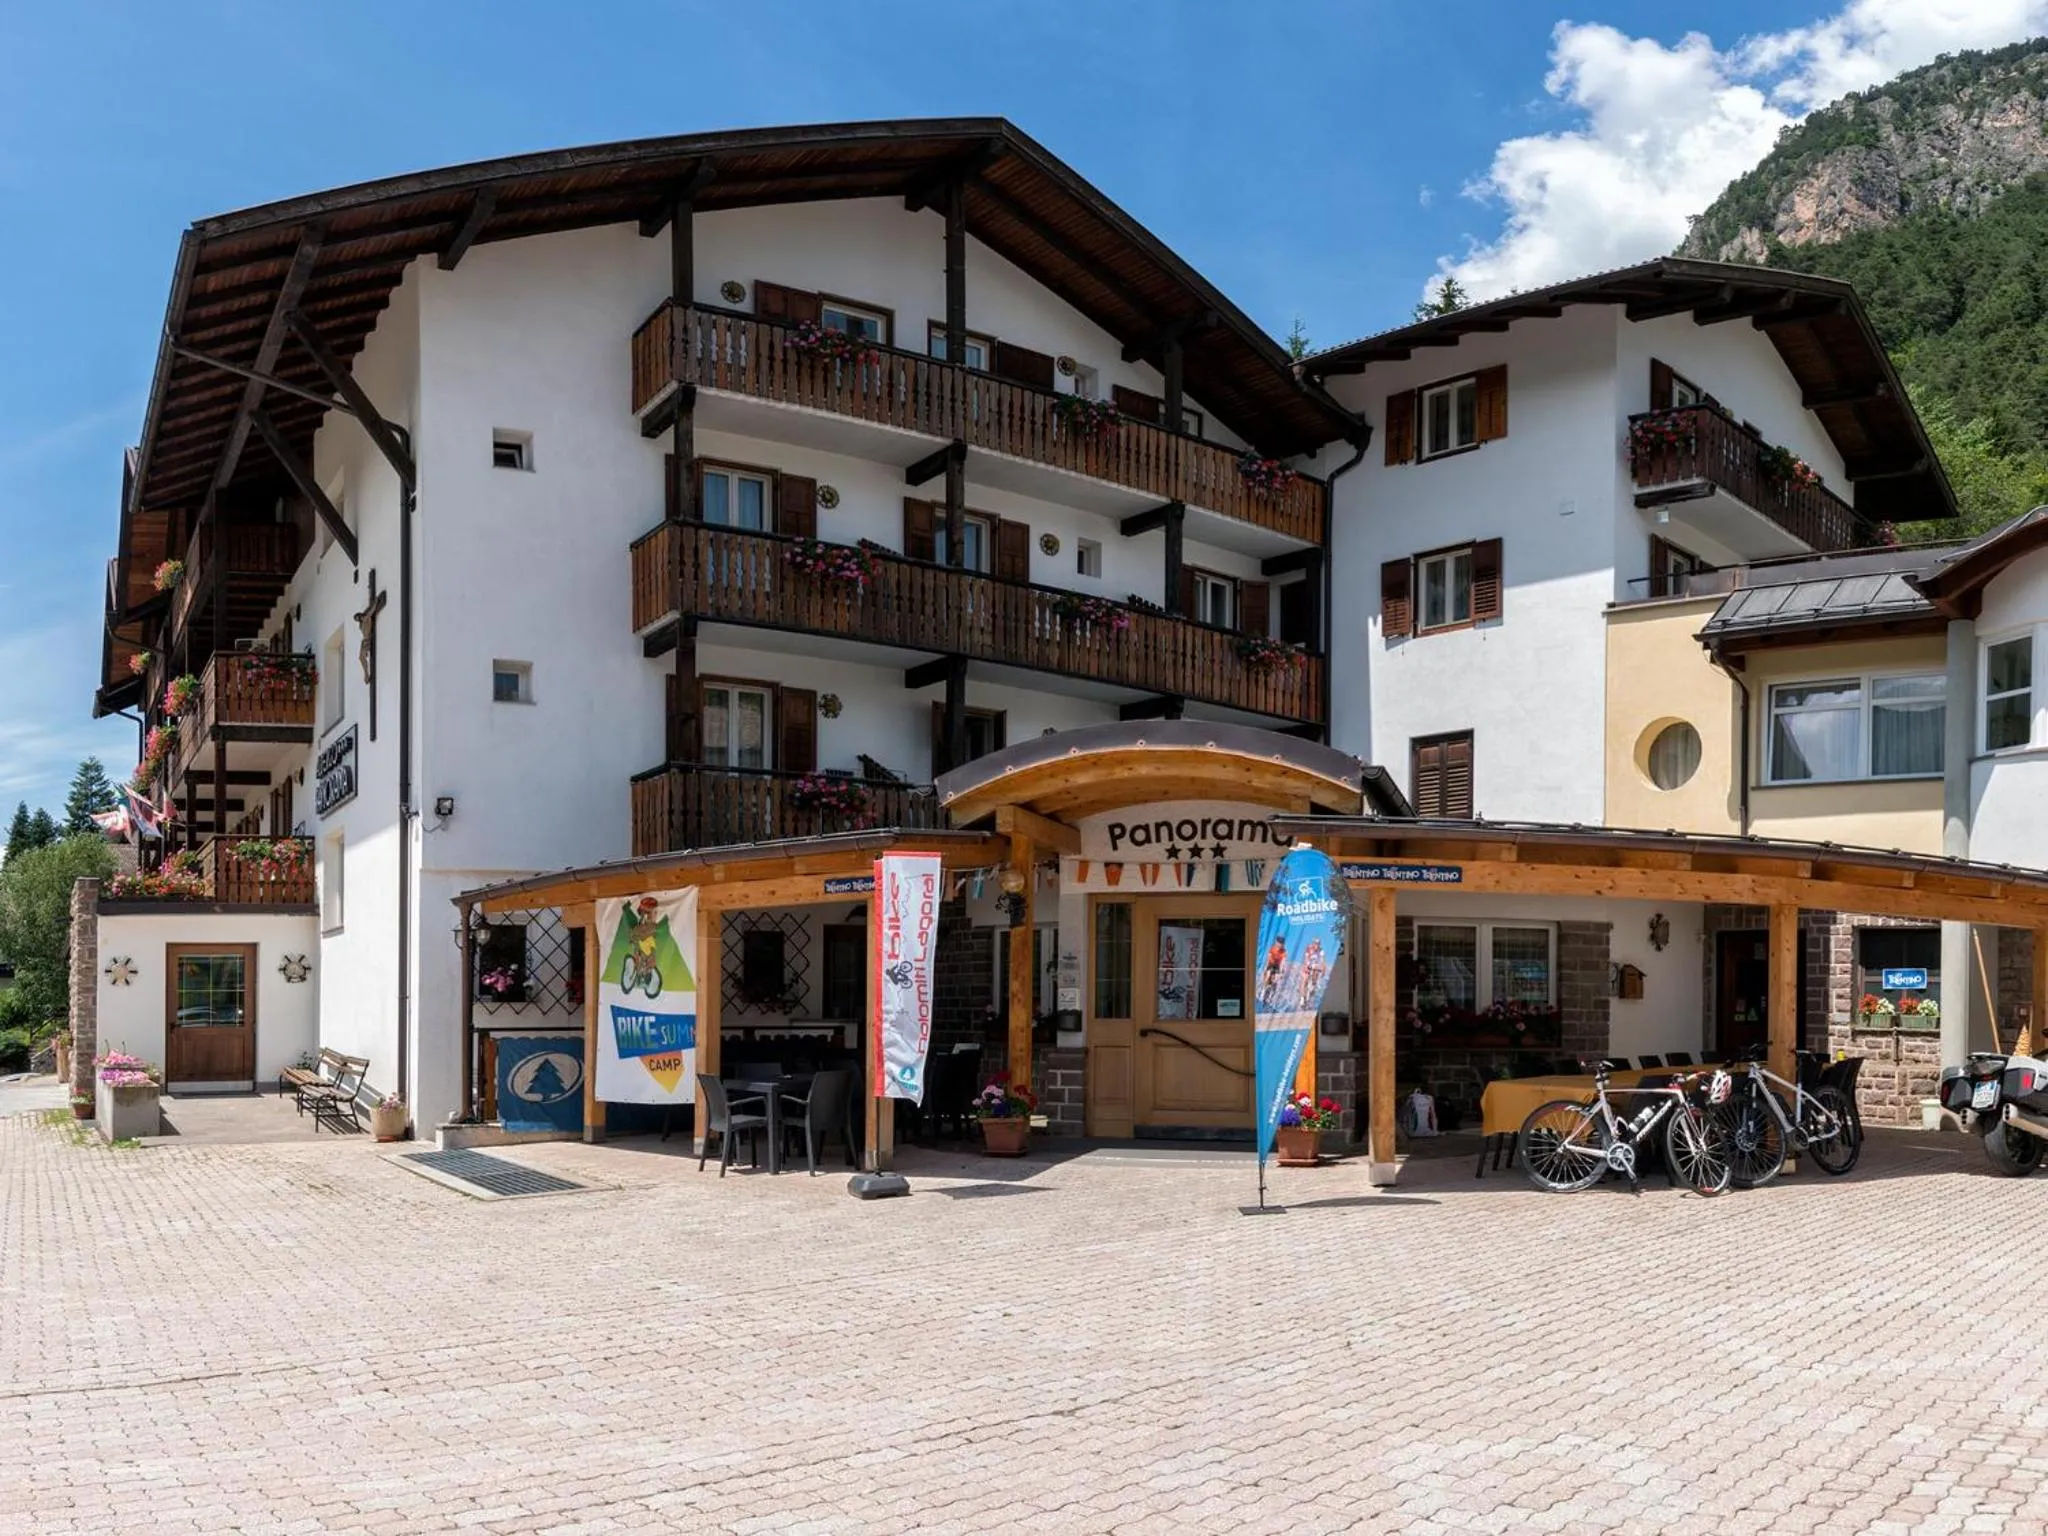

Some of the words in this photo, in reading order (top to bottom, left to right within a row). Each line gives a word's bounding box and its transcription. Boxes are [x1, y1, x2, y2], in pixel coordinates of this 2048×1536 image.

[1108, 818, 1293, 851] Panorama
[887, 872, 901, 960] bike
[1276, 899, 1339, 917] Roadbike
[616, 1015, 659, 1050] BIKE
[649, 1058, 681, 1072] CAMP
